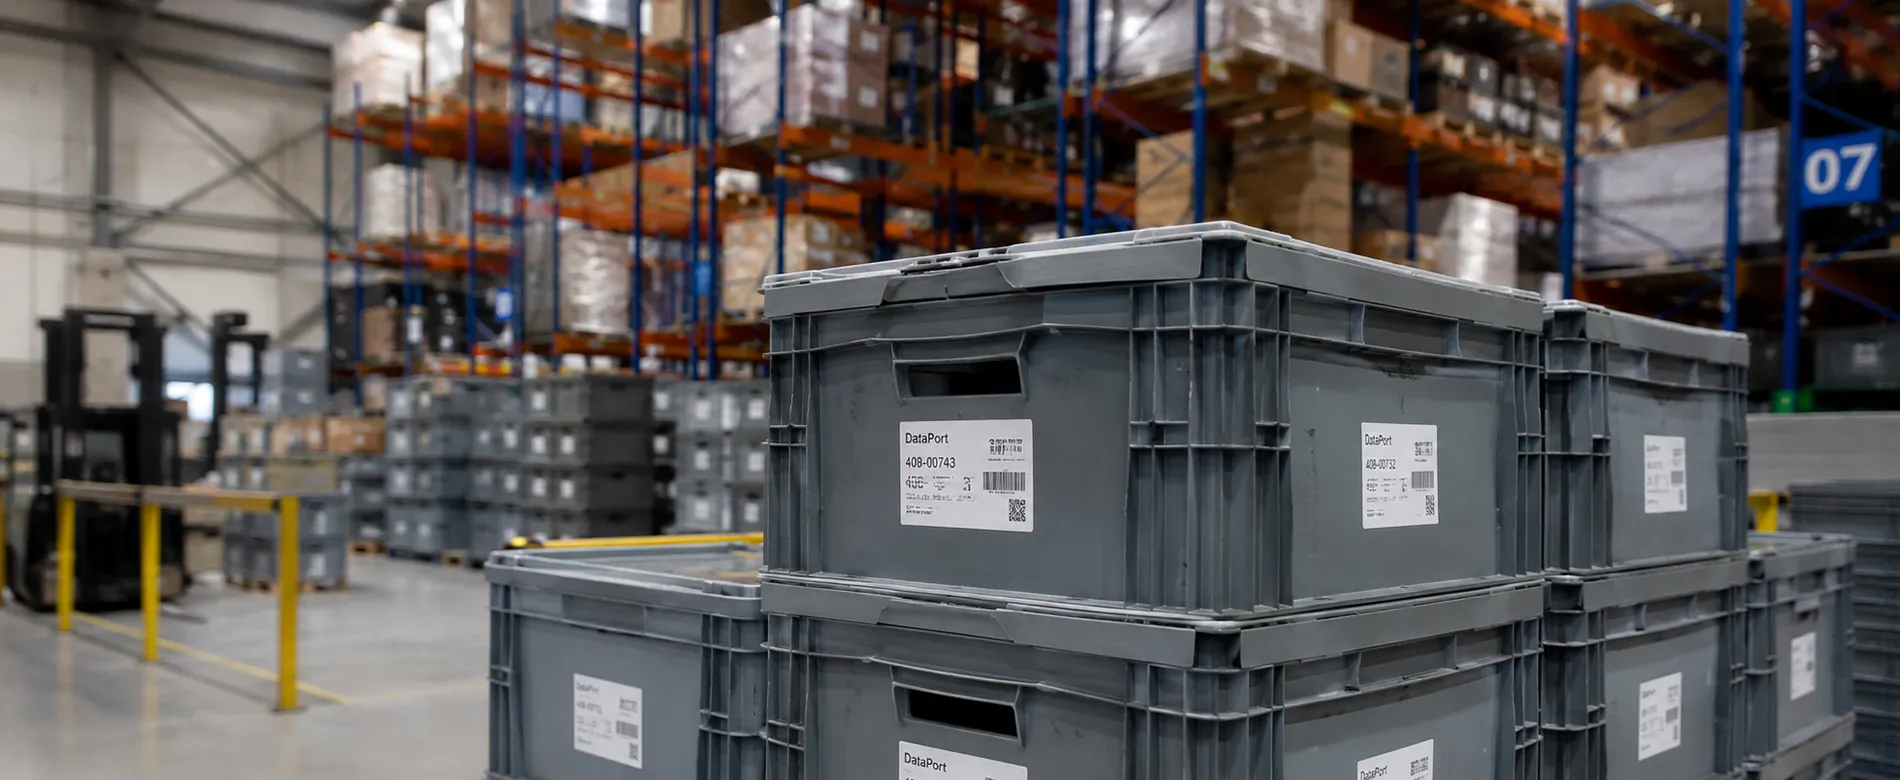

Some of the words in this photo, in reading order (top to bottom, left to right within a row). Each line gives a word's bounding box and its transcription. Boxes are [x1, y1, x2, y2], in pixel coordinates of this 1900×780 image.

[1804, 143, 1877, 196] 07
[905, 432, 949, 444] DataPort
[1364, 433, 1392, 446] DataPort
[905, 456, 956, 469] 408-00743
[904, 752, 947, 773] DataPort
